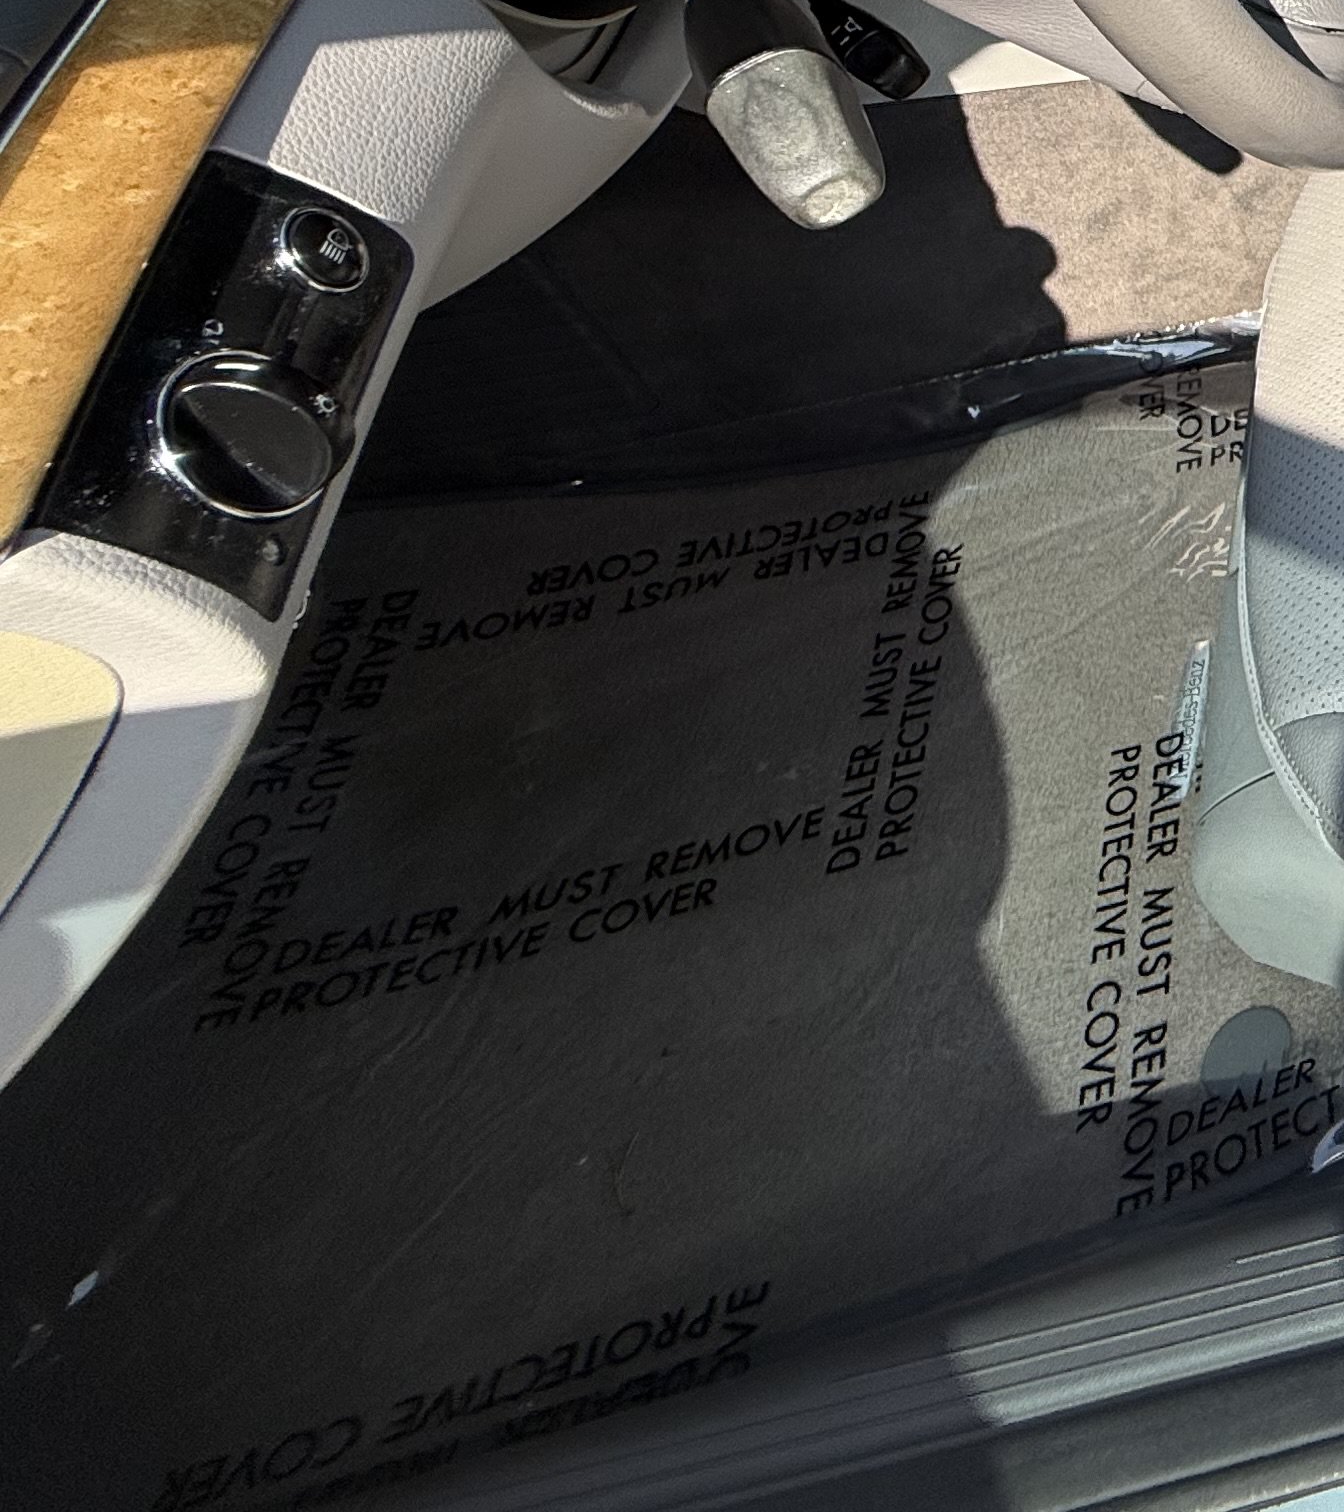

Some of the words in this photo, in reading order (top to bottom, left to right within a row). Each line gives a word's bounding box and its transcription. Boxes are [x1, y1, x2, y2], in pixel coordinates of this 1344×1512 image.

[527, 548, 658, 597] COVER
[616, 566, 731, 615] MUST
[678, 500, 893, 567] PROTECTIVE
[755, 536, 890, 580] DEALER
[881, 491, 932, 614] REMOVE
[340, 589, 418, 712] DEALER
[414, 595, 595, 651] REMOVE
[860, 631, 908, 719] MUST
[246, 598, 366, 796] PROTECTIVE
[875, 654, 943, 862] PROTECTIVE
[919, 542, 965, 647] COVER
[286, 737, 359, 834] MUST
[825, 738, 886, 876] DEALER
[1146, 730, 1185, 865] DEALER
[177, 813, 273, 948] COVER
[273, 905, 459, 974] DEALER
[487, 863, 625, 926] MUST
[644, 805, 827, 883] REMOVE
[1090, 743, 1143, 966] PROTECTIVE
[193, 855, 312, 1034] REMOVE
[249, 922, 551, 1023] PROTECTIVE
[568, 877, 718, 943] COVER
[1131, 885, 1176, 999] MUST
[1076, 978, 1124, 1134] COVER
[1114, 1020, 1168, 1218] REMOVE
[1166, 1057, 1316, 1147] DEALER
[377, 1294, 720, 1445] PROTECTIVE
[150, 1414, 364, 1512] COVER
